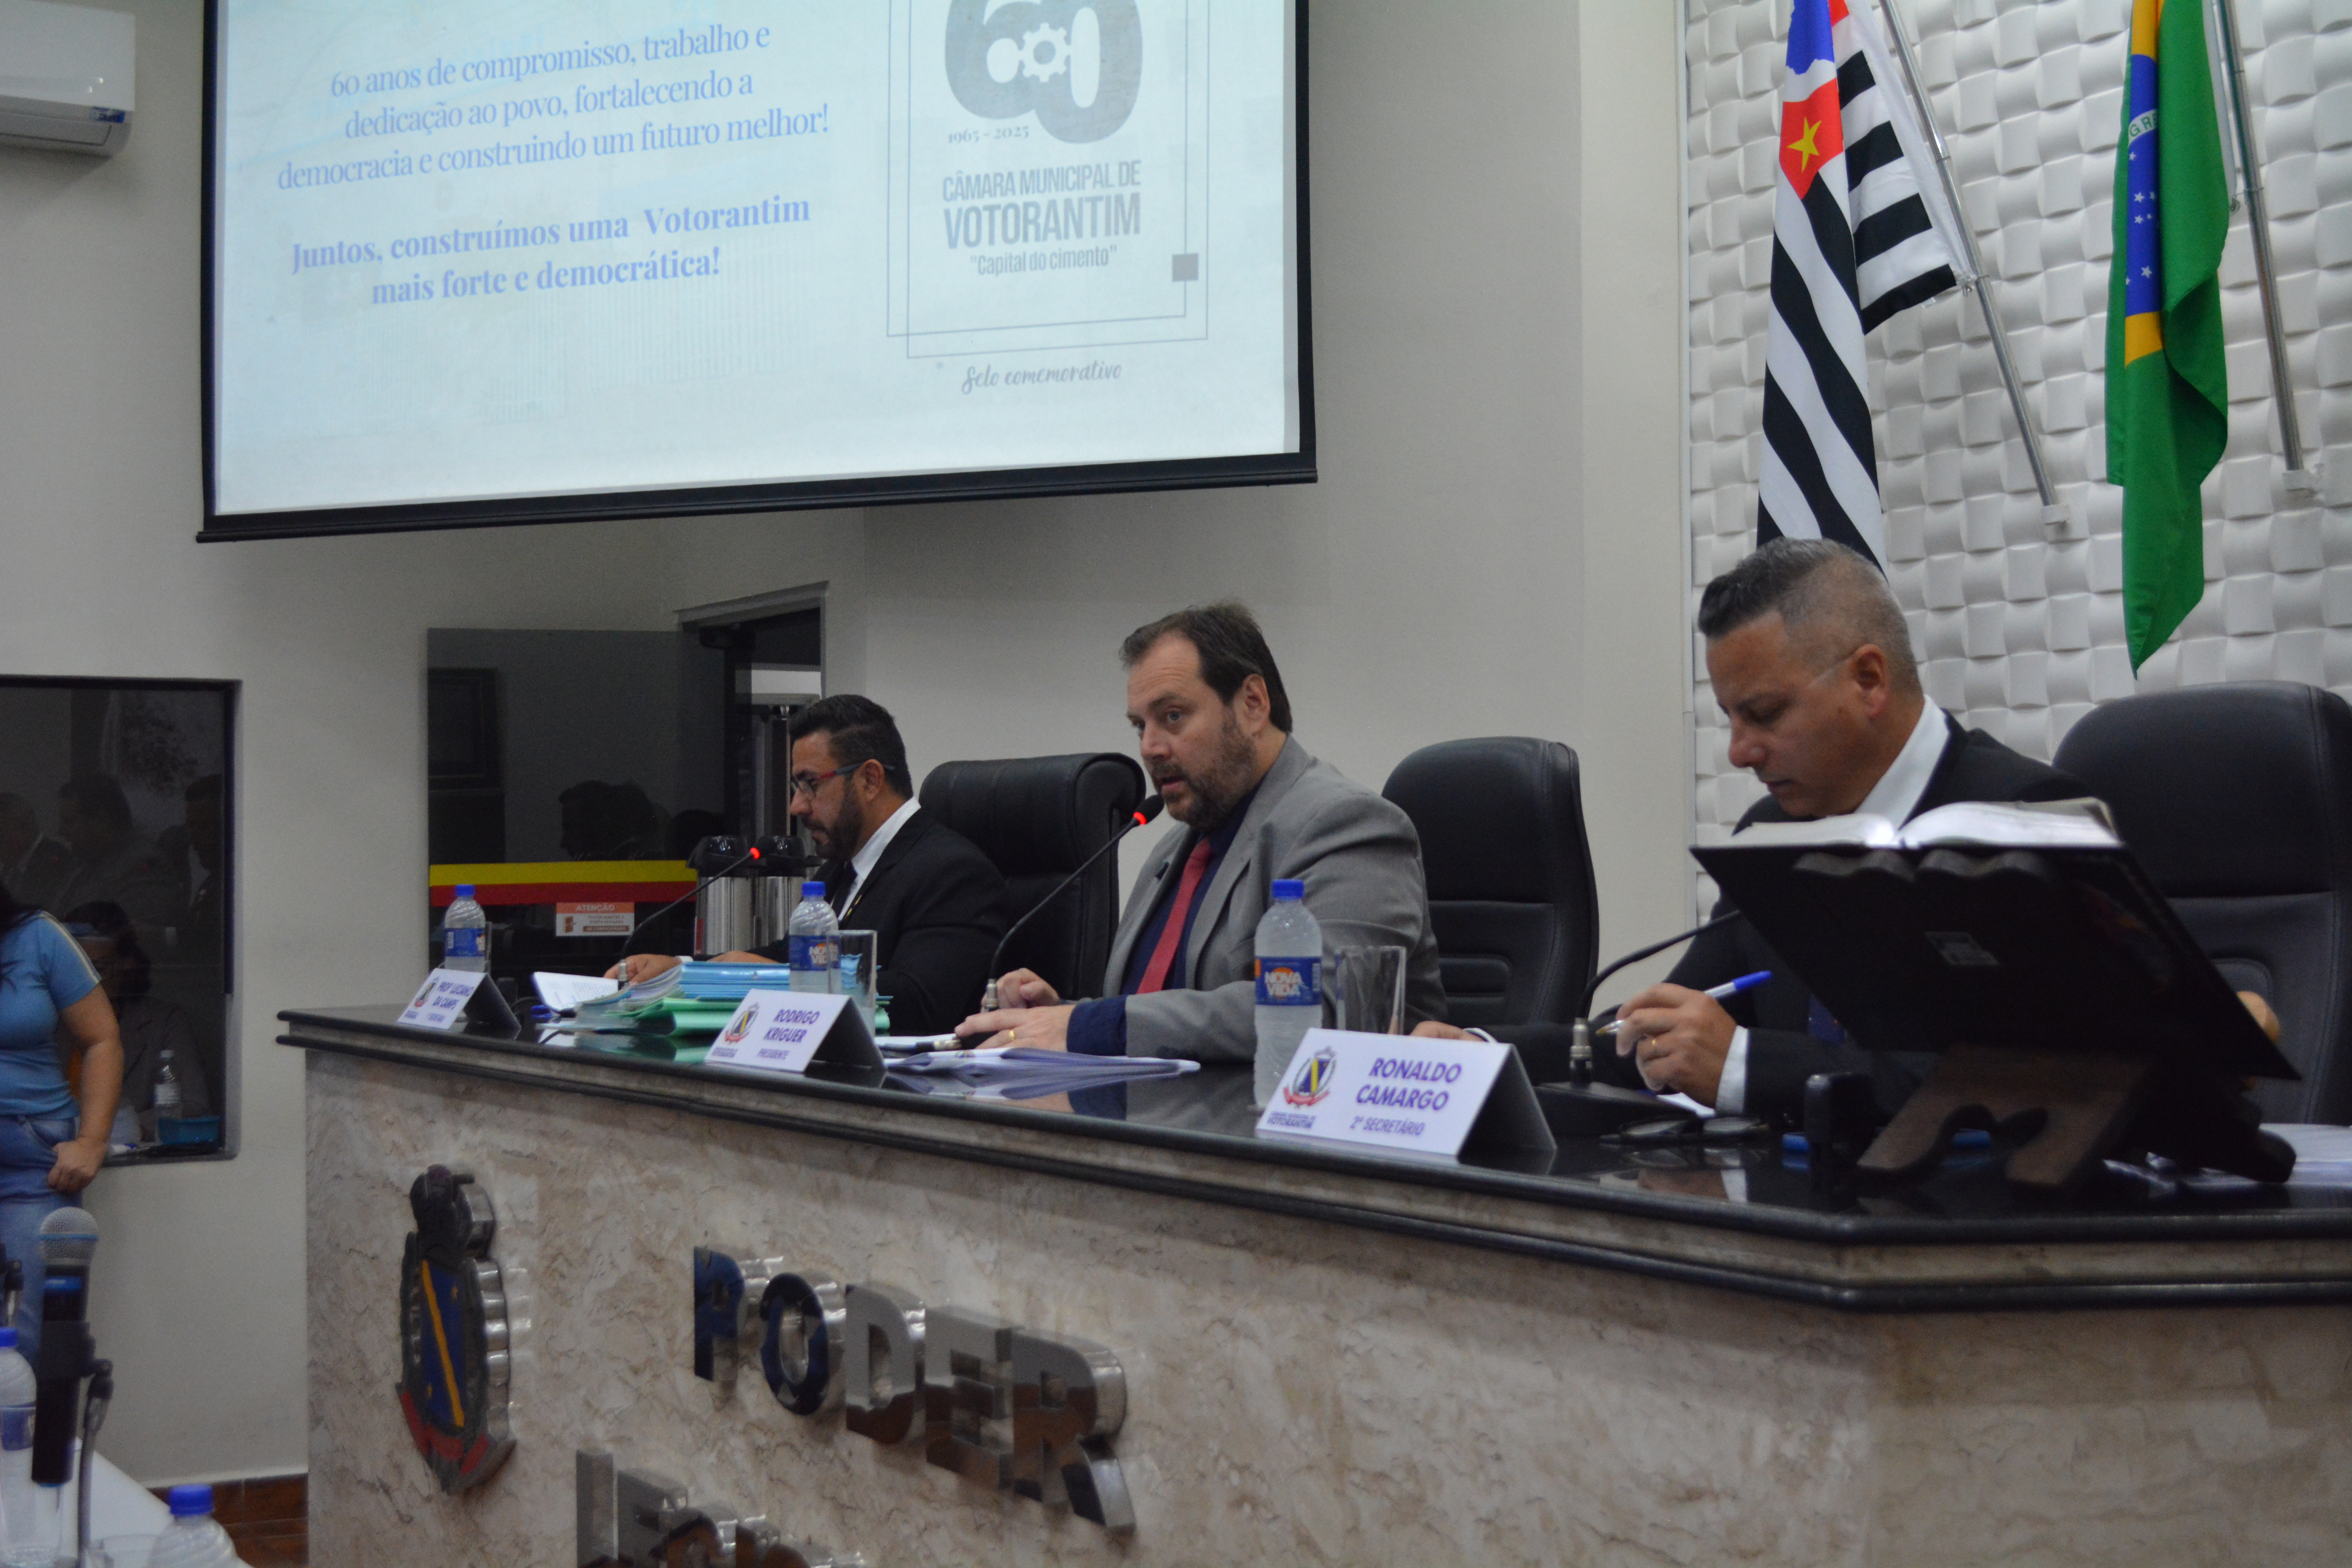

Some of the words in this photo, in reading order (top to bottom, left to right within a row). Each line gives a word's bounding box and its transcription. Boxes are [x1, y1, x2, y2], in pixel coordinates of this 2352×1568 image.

[331, 72, 360, 98] 60
[366, 68, 421, 94] anos
[428, 58, 456, 86] de
[462, 40, 637, 82] compromisso,
[643, 24, 749, 61] trabalho
[756, 26, 770, 47] e
[345, 101, 463, 139] dedicação
[468, 103, 497, 125] ao
[504, 95, 568, 127] povo,
[575, 69, 732, 113] fortalecendo
[739, 74, 753, 95] a
[278, 149, 413, 190] democracia
[419, 153, 432, 174] e
[439, 131, 586, 171] construindo
[593, 131, 635, 156] um
[641, 122, 720, 151] futuro
[726, 103, 828, 142] melhor!
[948, 128, 980, 145] 1965
[994, 126, 1029, 139] 2025
[943, 170, 1016, 202] CÂMARA
[1020, 162, 1116, 196] MUNICIPAL
[1118, 160, 1142, 187] DE
[292, 241, 383, 275] Juntos,
[391, 219, 560, 259] construímos
[569, 217, 629, 242] uma
[644, 194, 810, 234] Votorantim
[944, 192, 1140, 250] VOTORANTIM
[372, 273, 434, 304] mais
[441, 269, 507, 298] forte
[515, 270, 529, 291] e
[537, 246, 720, 290] democrática!
[970, 251, 1026, 277] "Capital
[1029, 250, 1047, 272] do
[1050, 245, 1117, 270] cimento"
[962, 364, 999, 395] Selo
[1005, 359, 1122, 385] comemorativo
[576, 903, 615, 913] ATENÇÃO
[1265, 971, 1302, 984] NOVA
[1267, 982, 1301, 996] VIDA
[773, 1009, 820, 1024] RODRIGO
[763, 1026, 808, 1043] KRIGUER
[1368, 1057, 1462, 1083] RONALDO
[1356, 1084, 1449, 1111] CAMARGO
[1363, 1117, 1426, 1136] SECRETÁRIO
[694, 1246, 1125, 1528] PODER
